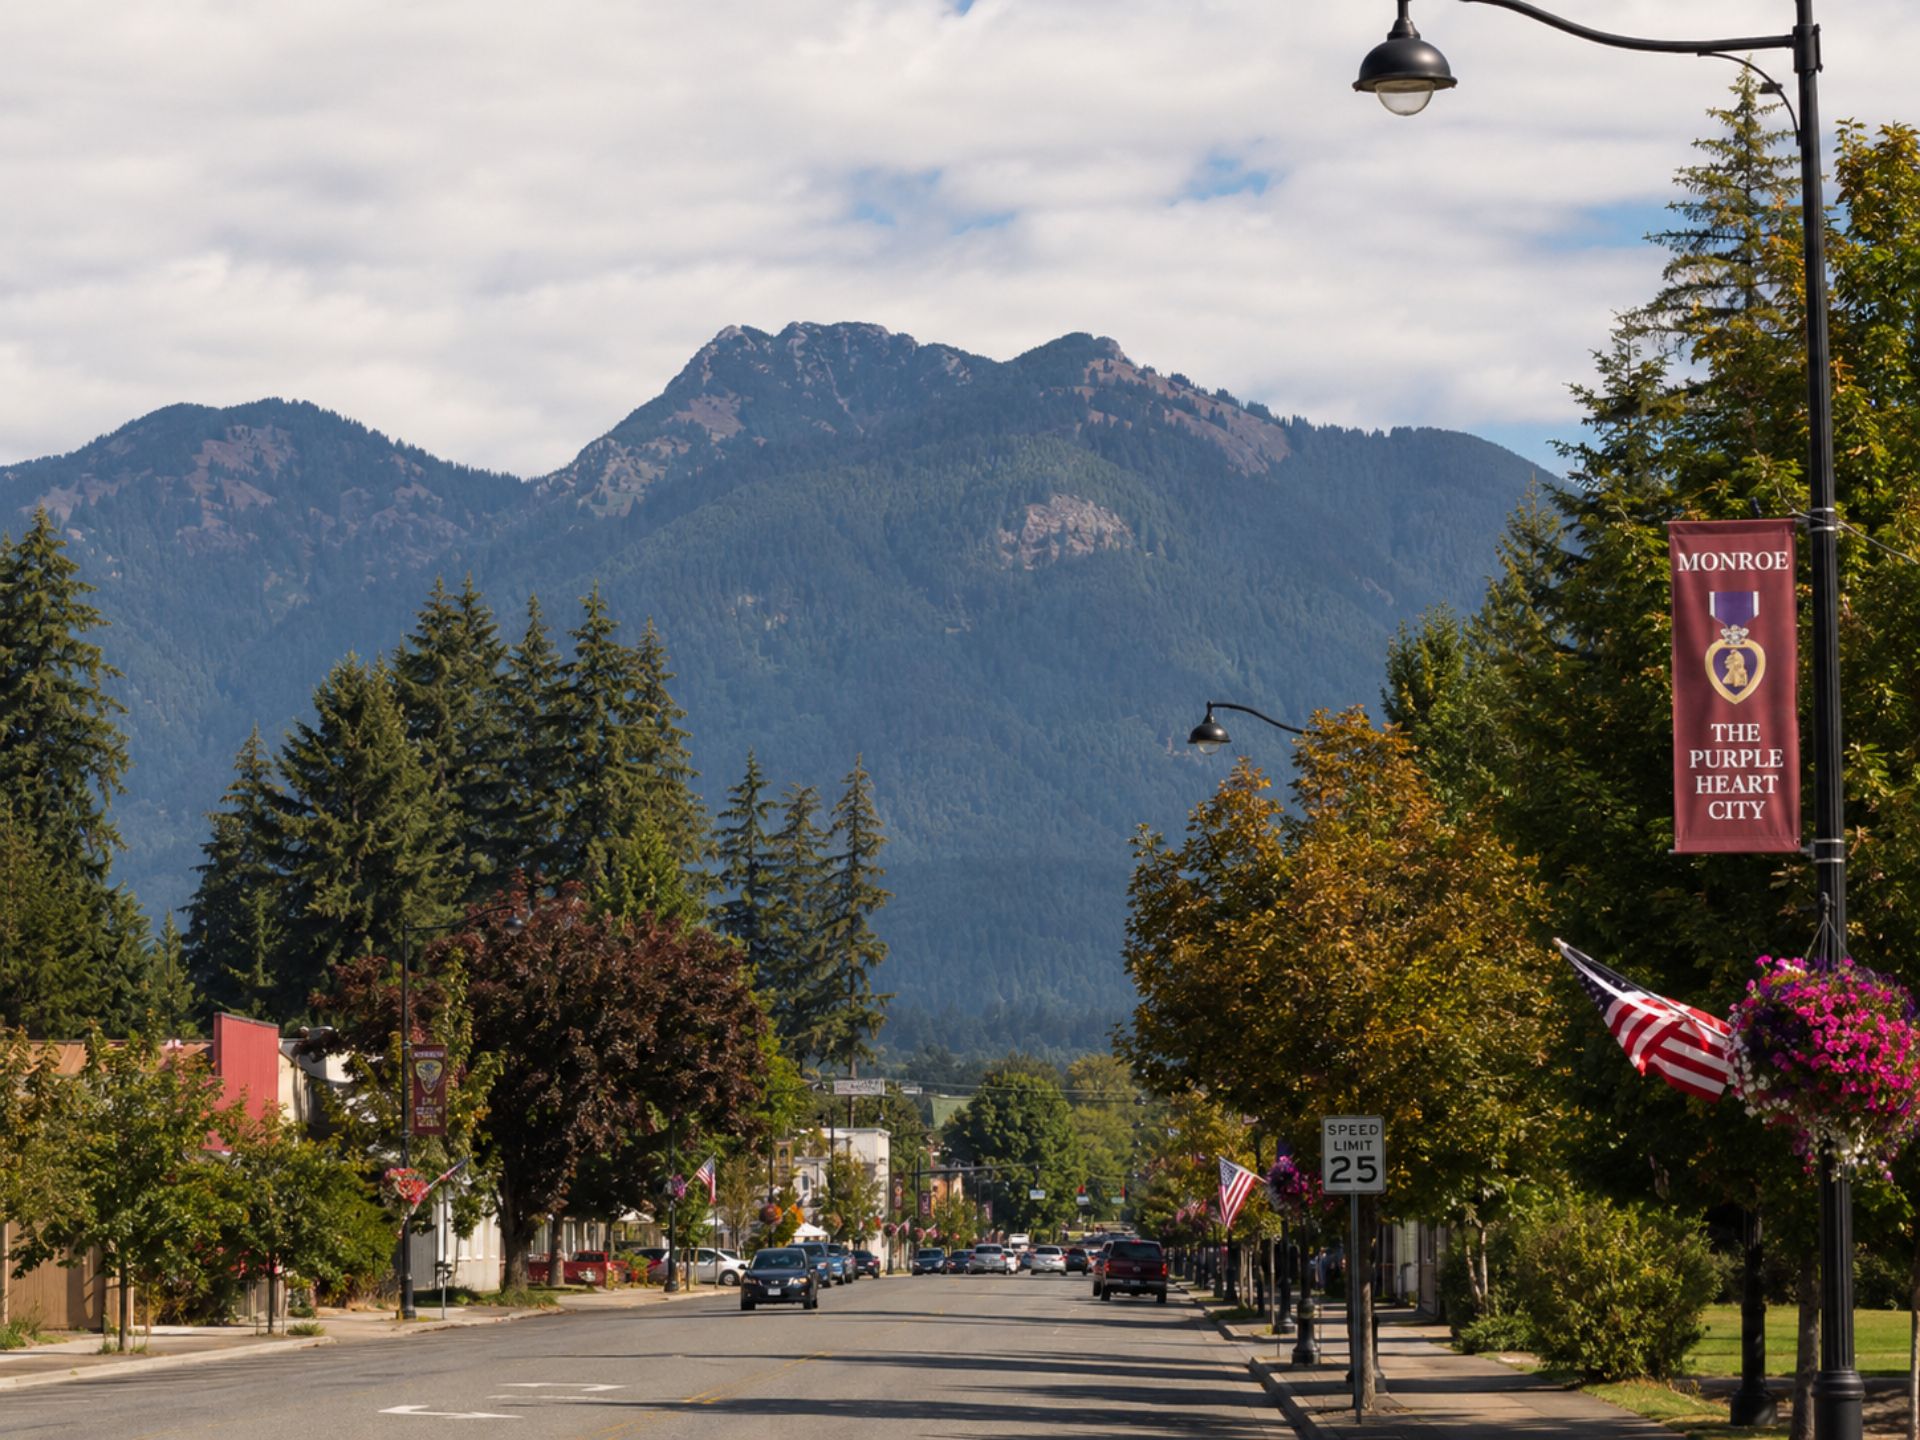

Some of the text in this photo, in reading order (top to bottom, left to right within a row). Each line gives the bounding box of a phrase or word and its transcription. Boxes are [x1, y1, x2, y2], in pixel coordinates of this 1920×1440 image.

[1678, 551, 1789, 572] MONROE
[1711, 723, 1761, 743] THE
[1689, 749, 1784, 769] PURPLE
[1695, 774, 1779, 795] HEART
[1708, 800, 1766, 820] CITY
[1328, 1124, 1379, 1136] SPEED
[1334, 1140, 1373, 1151] LIMIT
[1330, 1156, 1378, 1183] 25
